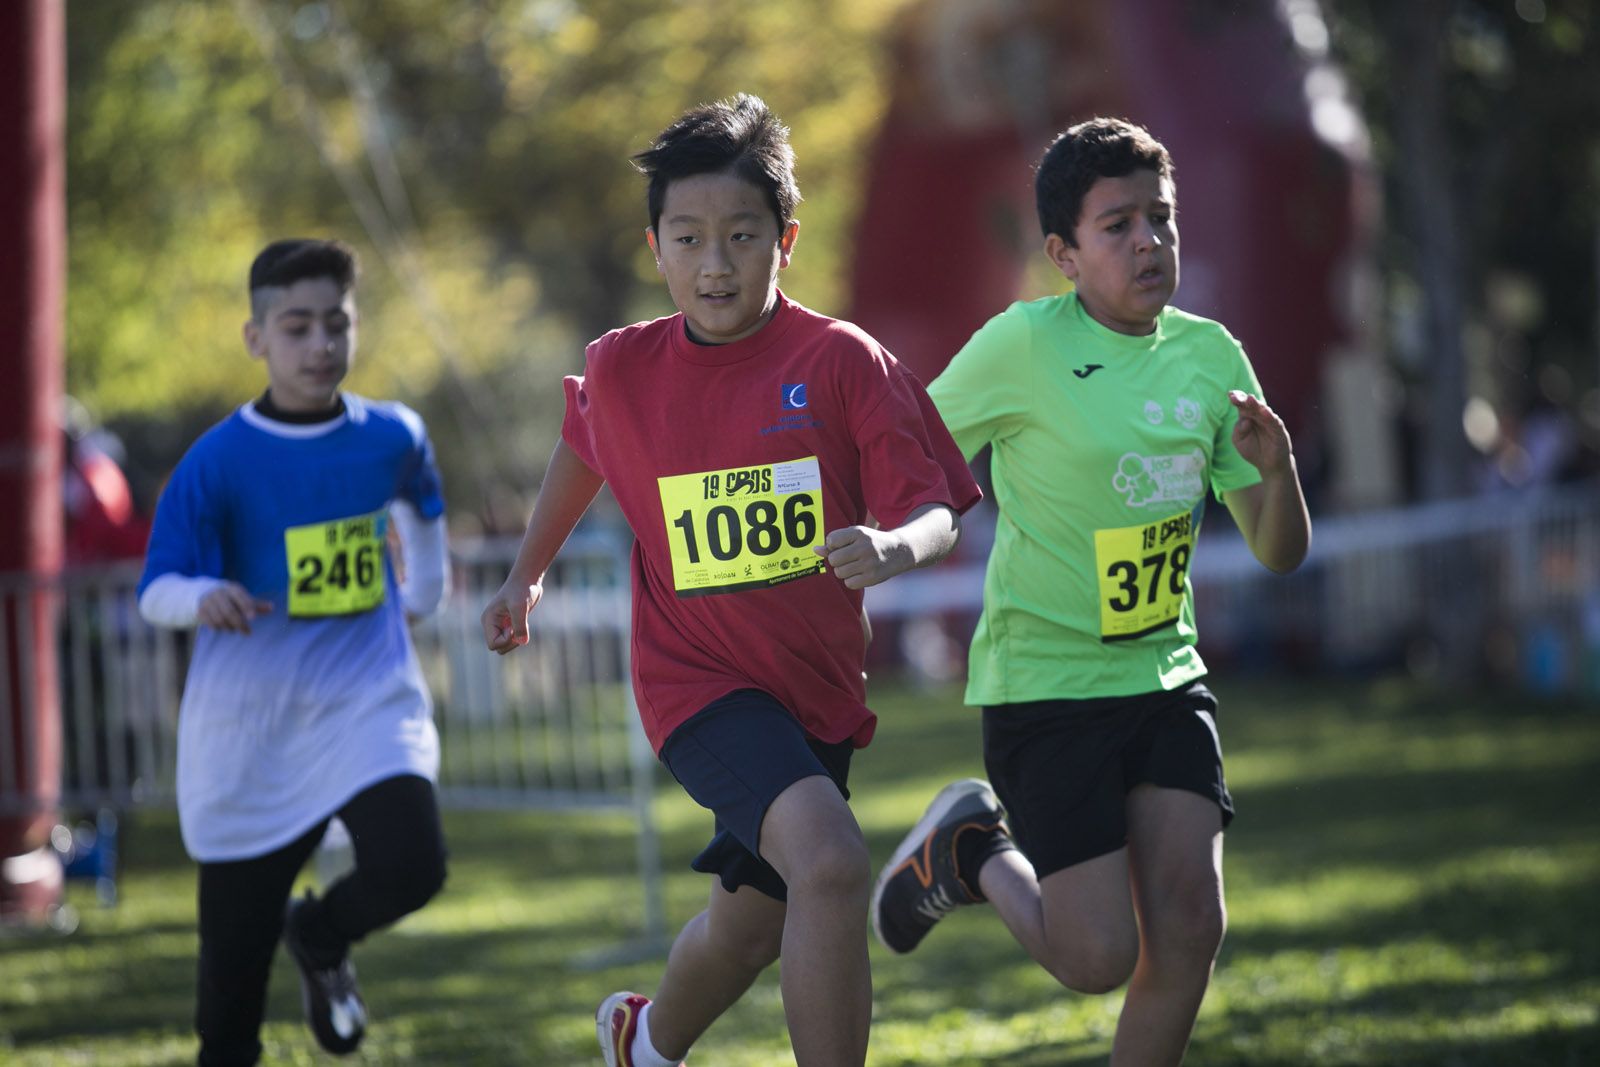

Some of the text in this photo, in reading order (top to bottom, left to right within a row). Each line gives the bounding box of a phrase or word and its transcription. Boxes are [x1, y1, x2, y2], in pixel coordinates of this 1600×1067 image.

[702, 474, 720, 500] 19
[673, 493, 817, 564] 1086
[1142, 525, 1156, 550] 19
[1107, 542, 1190, 613] 378
